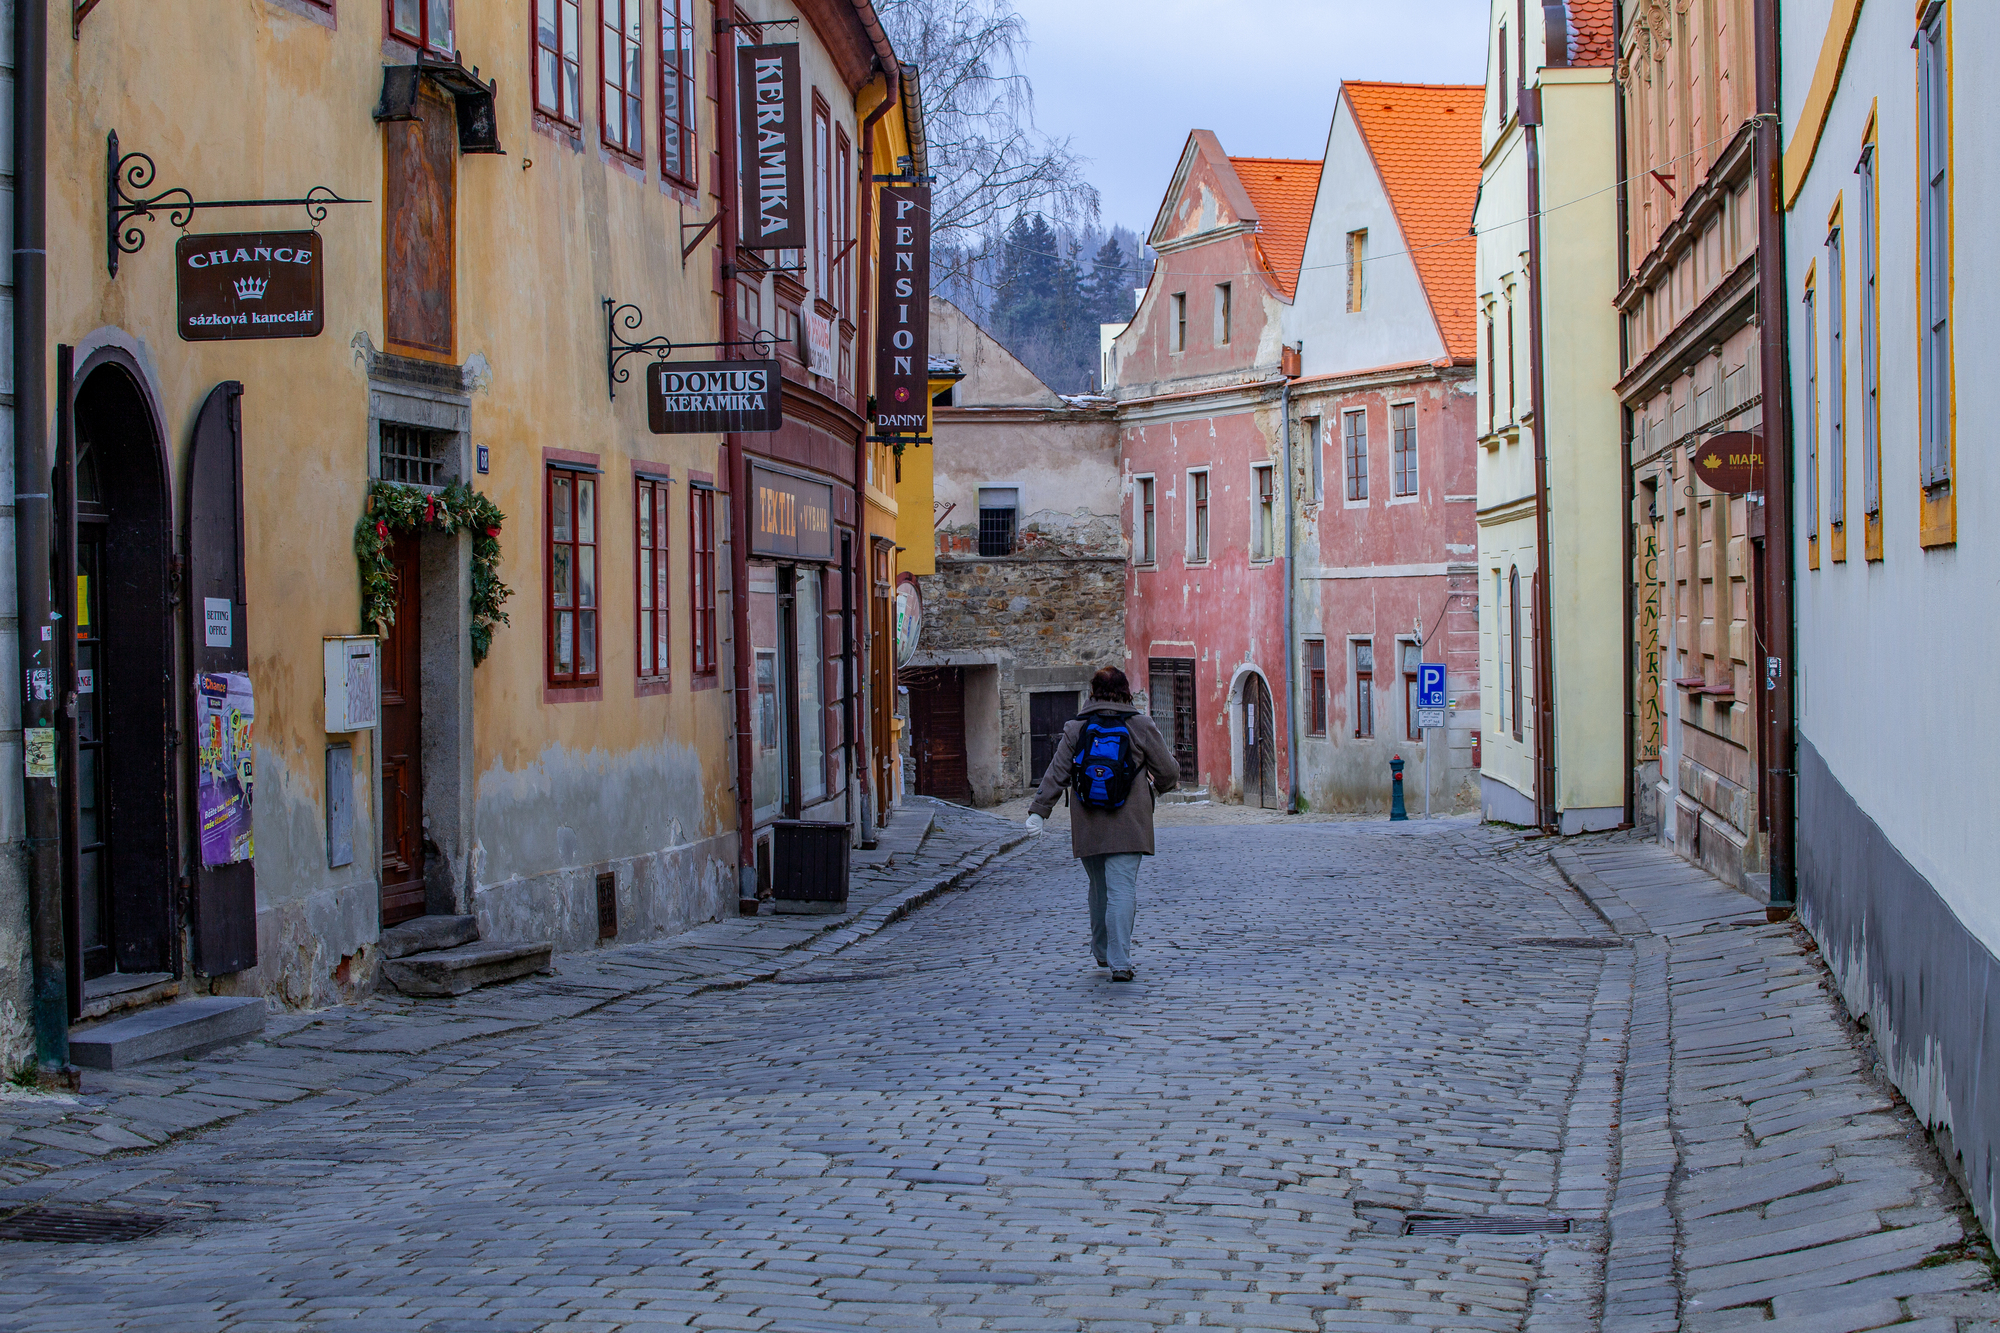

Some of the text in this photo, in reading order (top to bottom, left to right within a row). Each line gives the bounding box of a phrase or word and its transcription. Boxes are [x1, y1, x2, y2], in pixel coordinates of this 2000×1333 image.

[755, 57, 788, 237] KERAMIKA
[188, 247, 312, 268] CHANCE
[893, 200, 914, 376] PENSION
[189, 310, 314, 326] sázková kancelář
[664, 371, 765, 393] DOMUS
[665, 394, 765, 412] KERAMIKA
[878, 414, 926, 426] DANNY
[760, 486, 796, 537] TEXTIL
[206, 610, 229, 621] BETTING
[208, 625, 228, 636] OFFICE
[1424, 669, 1440, 693] P
